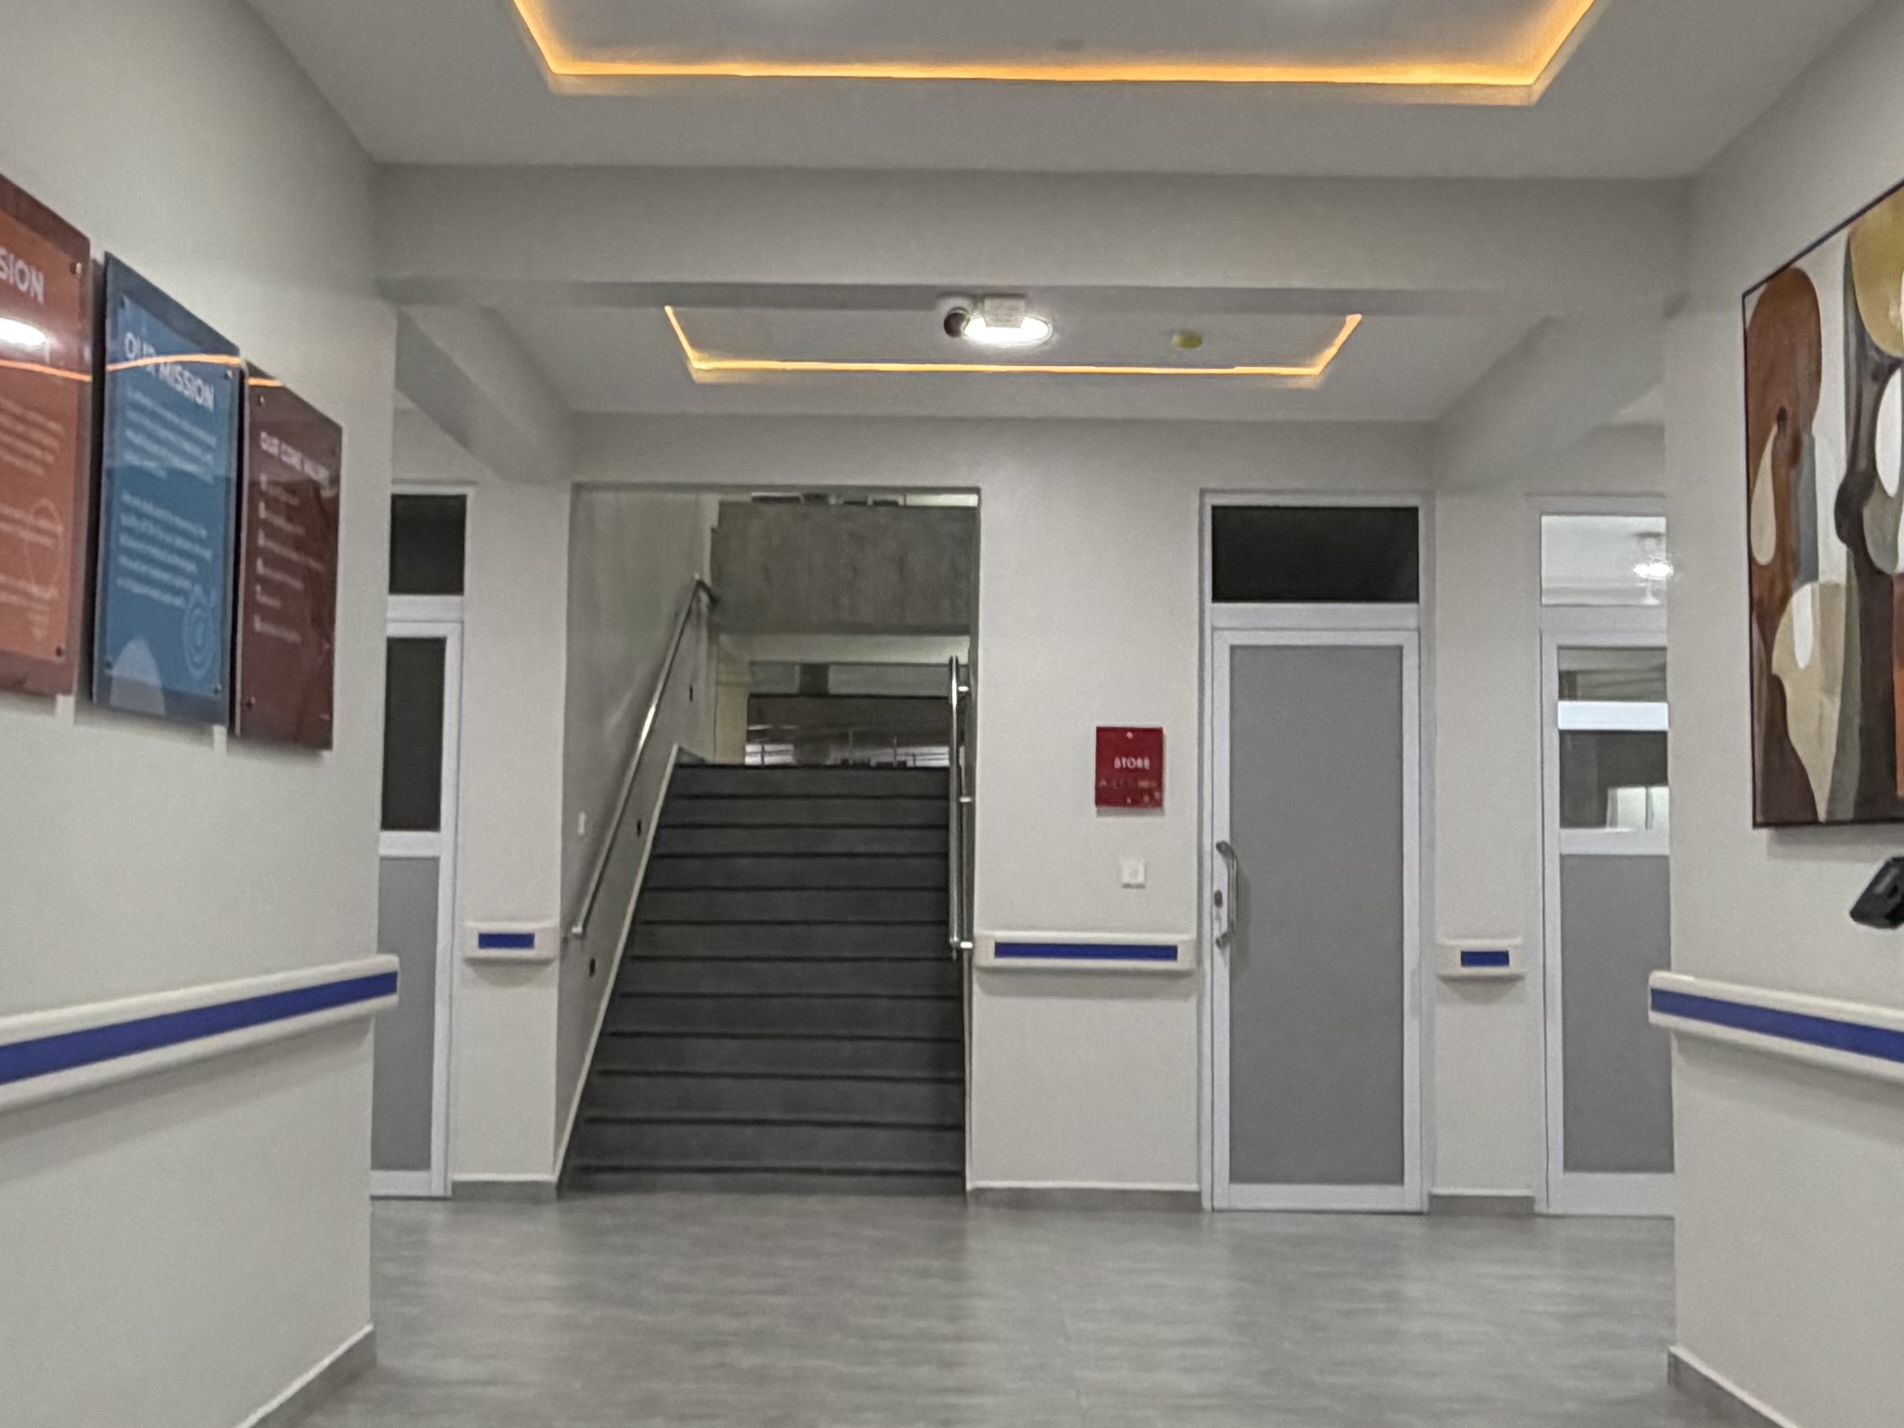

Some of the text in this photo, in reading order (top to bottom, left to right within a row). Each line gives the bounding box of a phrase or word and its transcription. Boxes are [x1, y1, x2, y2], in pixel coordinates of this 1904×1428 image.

[124, 331, 215, 412] OUR MISSION
[1114, 756, 1151, 770] STORE
